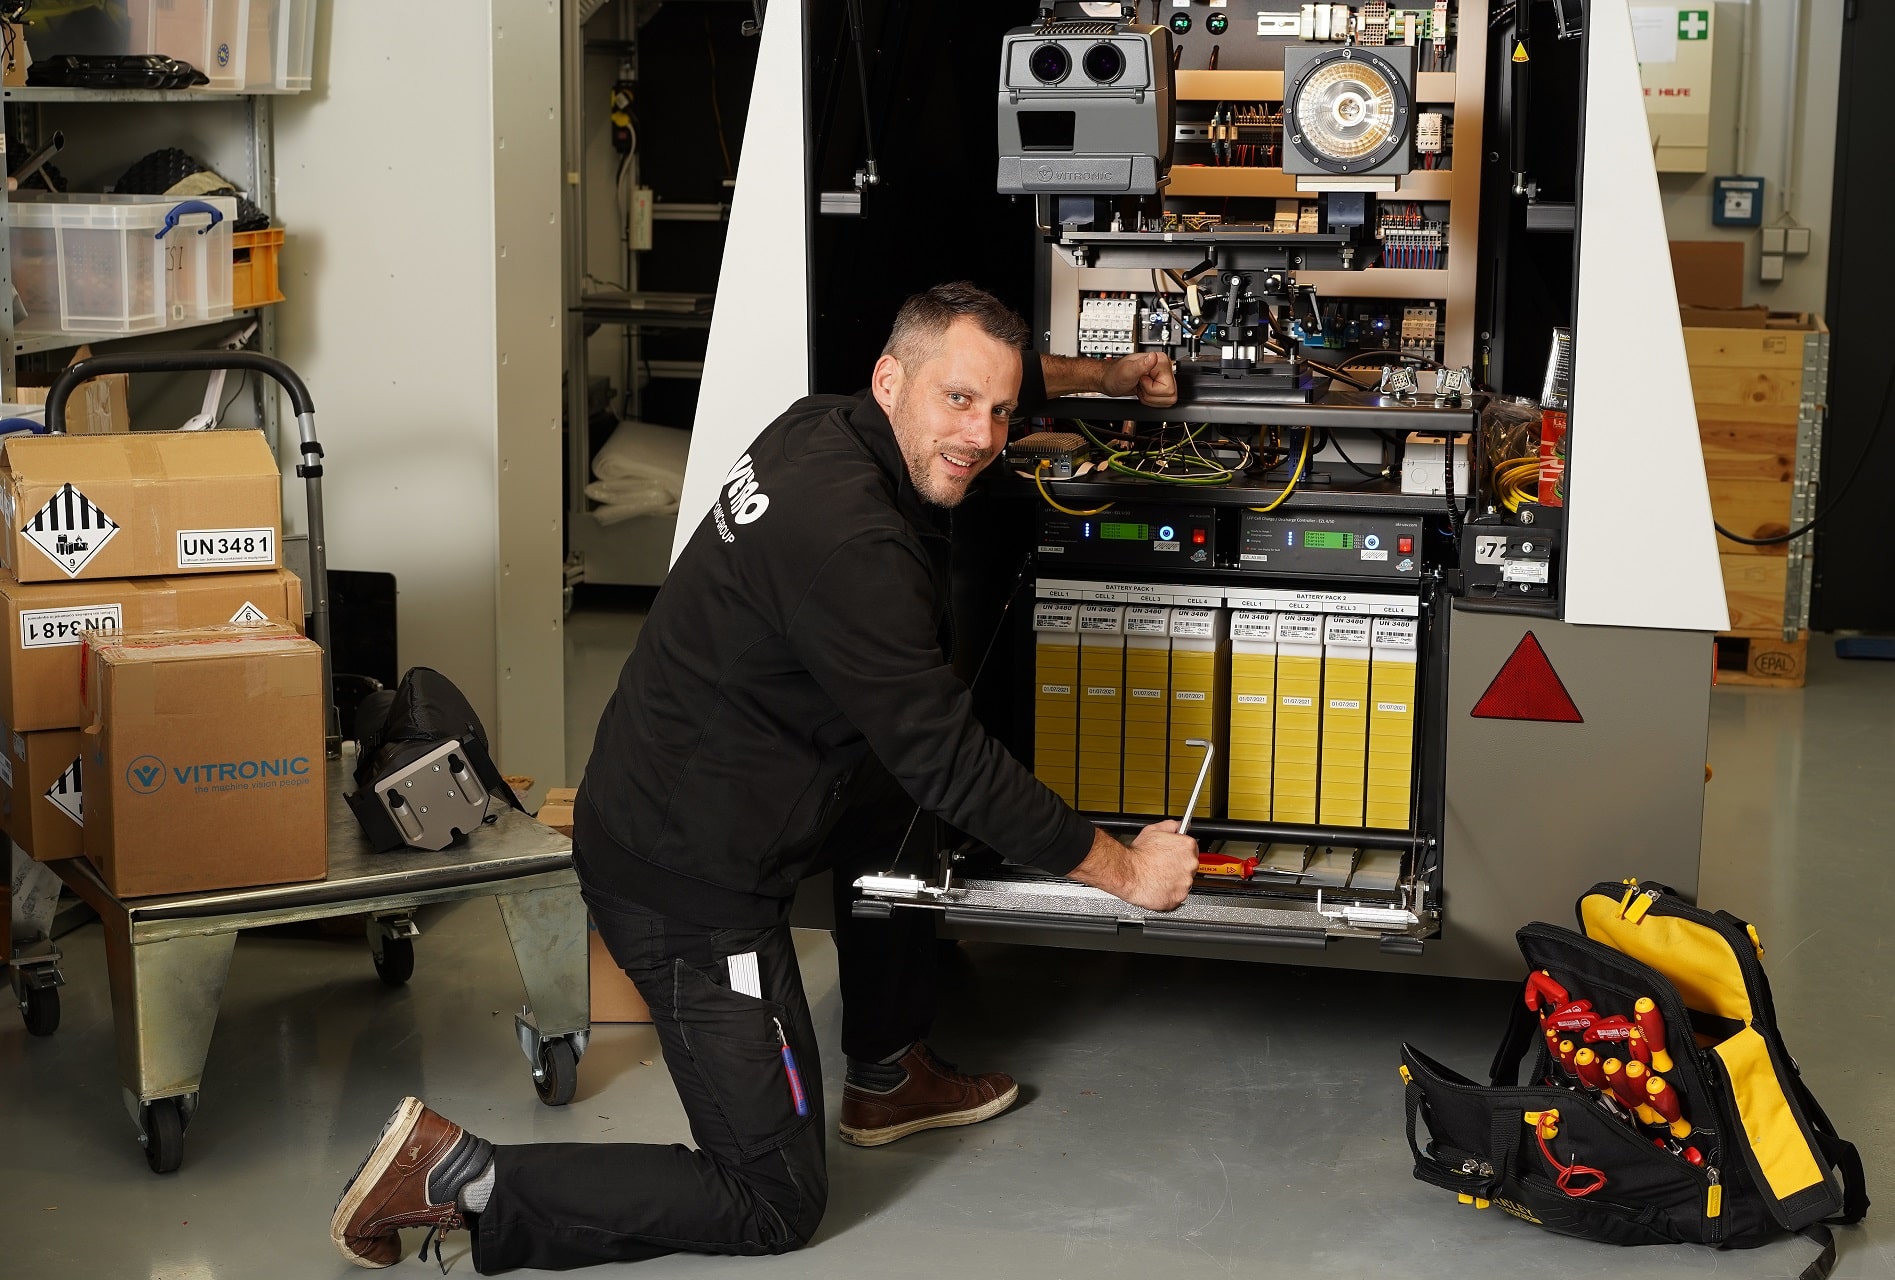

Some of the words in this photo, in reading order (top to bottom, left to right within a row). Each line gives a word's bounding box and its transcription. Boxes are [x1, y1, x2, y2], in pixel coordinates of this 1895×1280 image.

[1659, 88, 1691, 96] HILFE
[1055, 171, 1113, 181] VITRONIC
[722, 453, 770, 525] VERO
[183, 539, 214, 556] UN
[218, 536, 267, 554] 3481
[69, 559, 76, 567] 9
[29, 620, 81, 641] 3481
[1761, 657, 1789, 671] EPAL
[173, 757, 310, 785] VITRONIC
[195, 785, 209, 793] the
[211, 782, 249, 792] machine
[251, 780, 277, 789] vision
[279, 777, 310, 788] people
